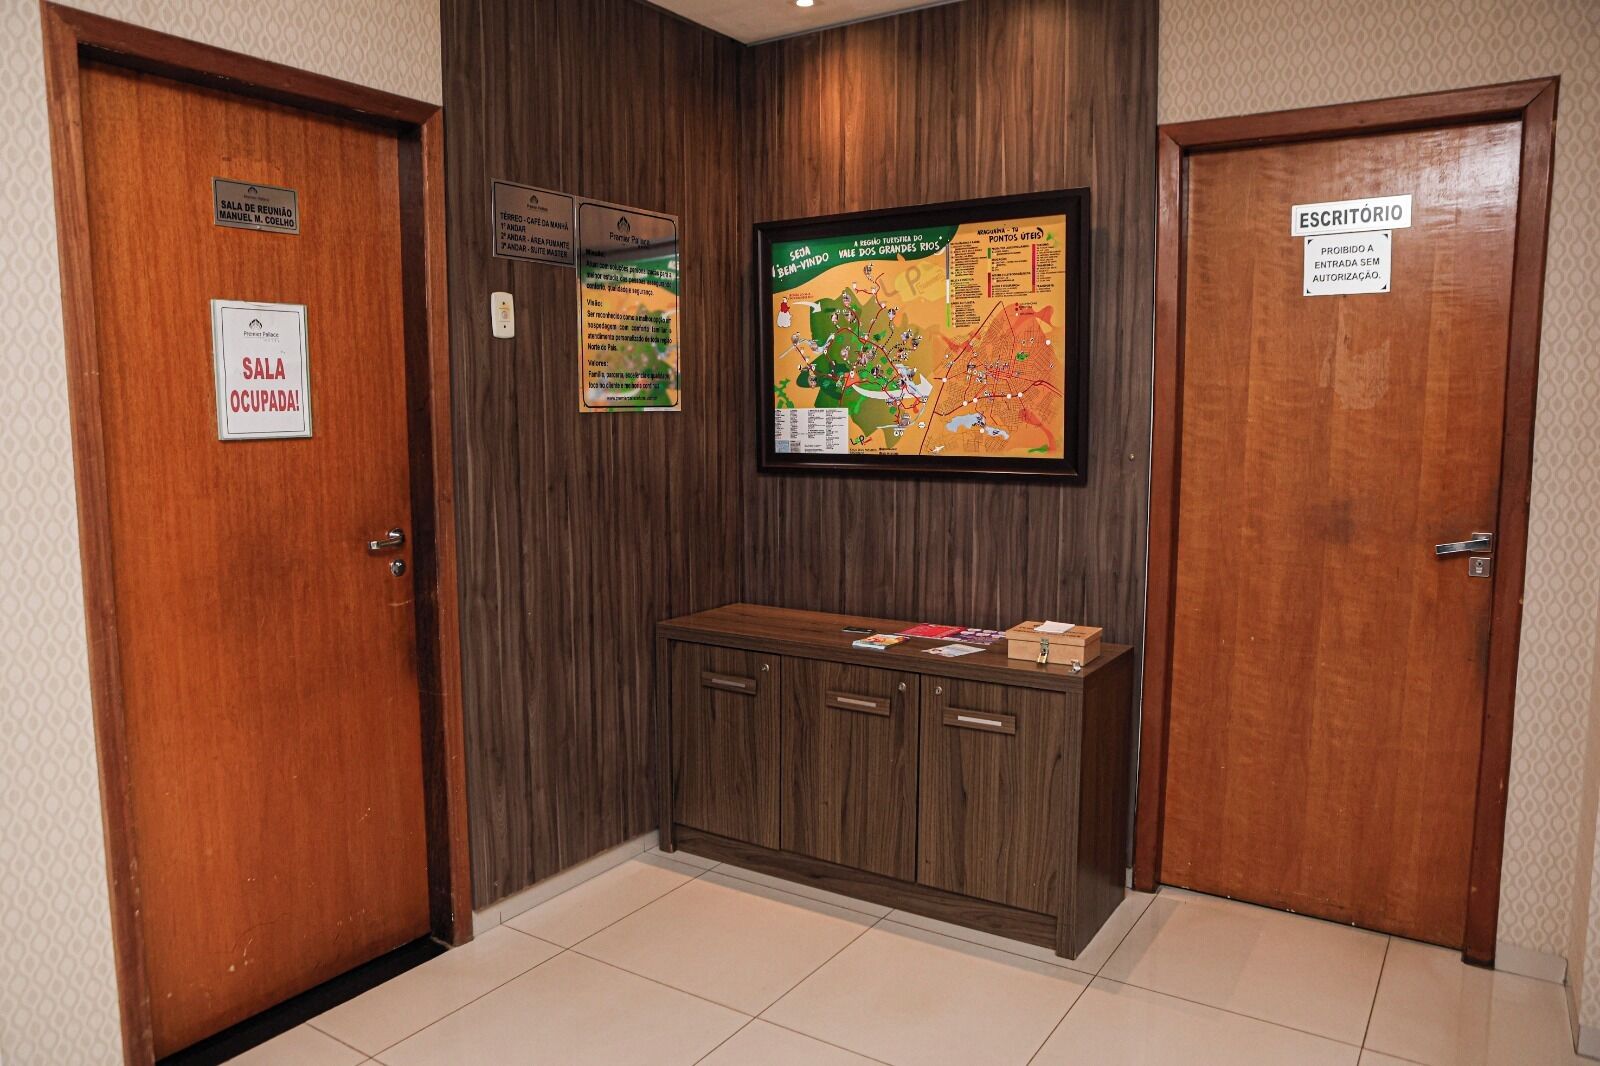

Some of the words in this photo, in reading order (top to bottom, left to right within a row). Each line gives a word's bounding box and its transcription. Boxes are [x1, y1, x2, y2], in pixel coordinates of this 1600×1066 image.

[221, 200, 243, 211] SALA
[245, 203, 256, 213] DE
[257, 205, 293, 218] REUNIÃO
[1300, 203, 1403, 229] ESCRITÓRIO
[219, 210, 253, 222] MANUEL
[254, 215, 263, 224] M.
[265, 216, 295, 228] COELHO
[500, 211, 523, 223] TÉRREO
[527, 216, 541, 226] CAFÉ
[542, 219, 550, 227] DA
[507, 224, 526, 233] ANDAR
[507, 233, 527, 243] ANDAR
[531, 235, 545, 245] ÁREA
[546, 239, 570, 250] FUMANTE
[853, 240, 859, 248] A
[859, 237, 881, 247] REGIÃO
[913, 234, 923, 242] DO
[989, 233, 1018, 243] PONTOS
[1021, 231, 1042, 240] ÚTEIS
[508, 243, 527, 252] ANDAR
[546, 247, 568, 258] MASTER
[789, 245, 811, 262] SEJA
[838, 248, 856, 259] VALE
[859, 247, 876, 257] DOS
[879, 243, 917, 255] GRANDES
[920, 241, 940, 251] RIOS
[1321, 244, 1365, 255] PROIBIDO
[1367, 244, 1374, 253] A
[778, 253, 829, 279] BEM-VINDO
[1314, 258, 1358, 270] ENTRADA
[1360, 257, 1380, 267] SEM
[1312, 270, 1381, 283] AUTORIZAÇÃO.
[587, 310, 595, 318] Ser
[596, 311, 623, 320] reconhecido
[587, 343, 600, 351] Norte
[242, 357, 286, 380] SALA
[230, 389, 300, 413] OCUPADA!
